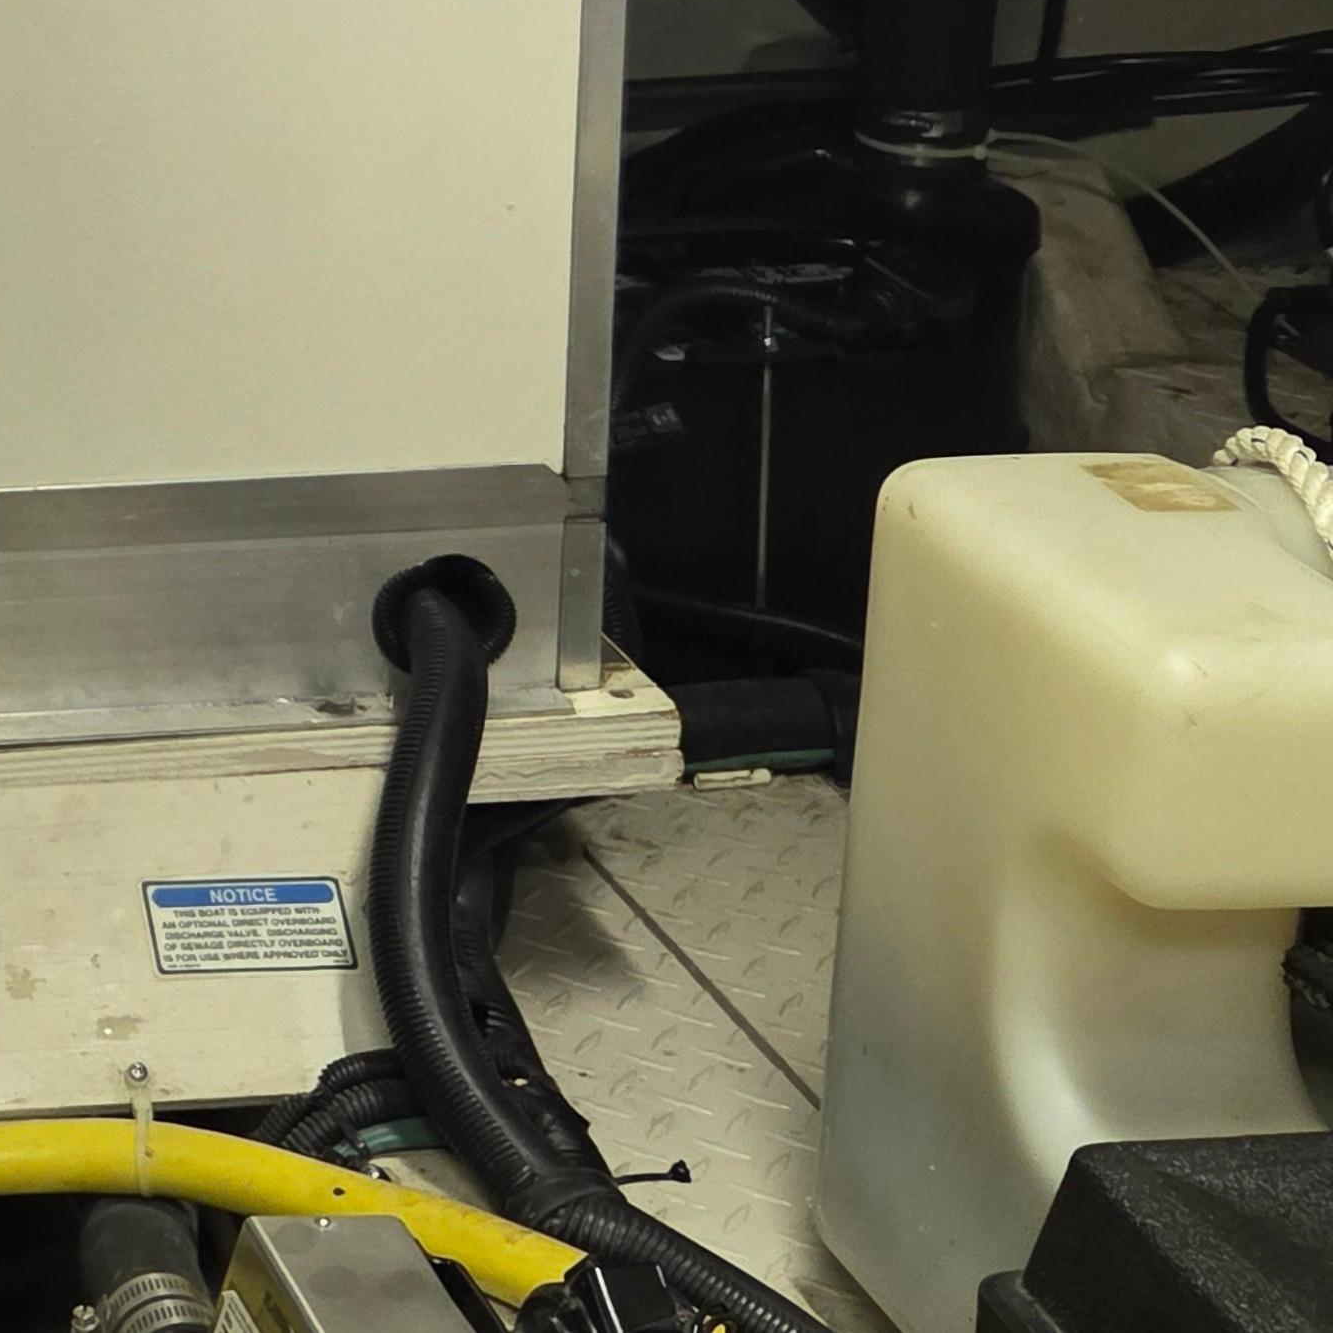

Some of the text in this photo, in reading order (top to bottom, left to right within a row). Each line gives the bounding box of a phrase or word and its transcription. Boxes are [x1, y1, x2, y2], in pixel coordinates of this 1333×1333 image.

[209, 887, 278, 904] NOTICE
[174, 909, 196, 918] THIS
[198, 908, 225, 917] BOAT
[294, 906, 321, 915] WITH
[178, 919, 230, 928] OPTIONAL
[231, 917, 268, 927] DIRECT
[271, 916, 337, 926] OVERBOARD
[165, 931, 225, 940] DISCHARGE
[227, 939, 276, 948] DIRECTLY
[278, 938, 344, 948] OVERBOARD
[263, 949, 319, 959] APPROVED
